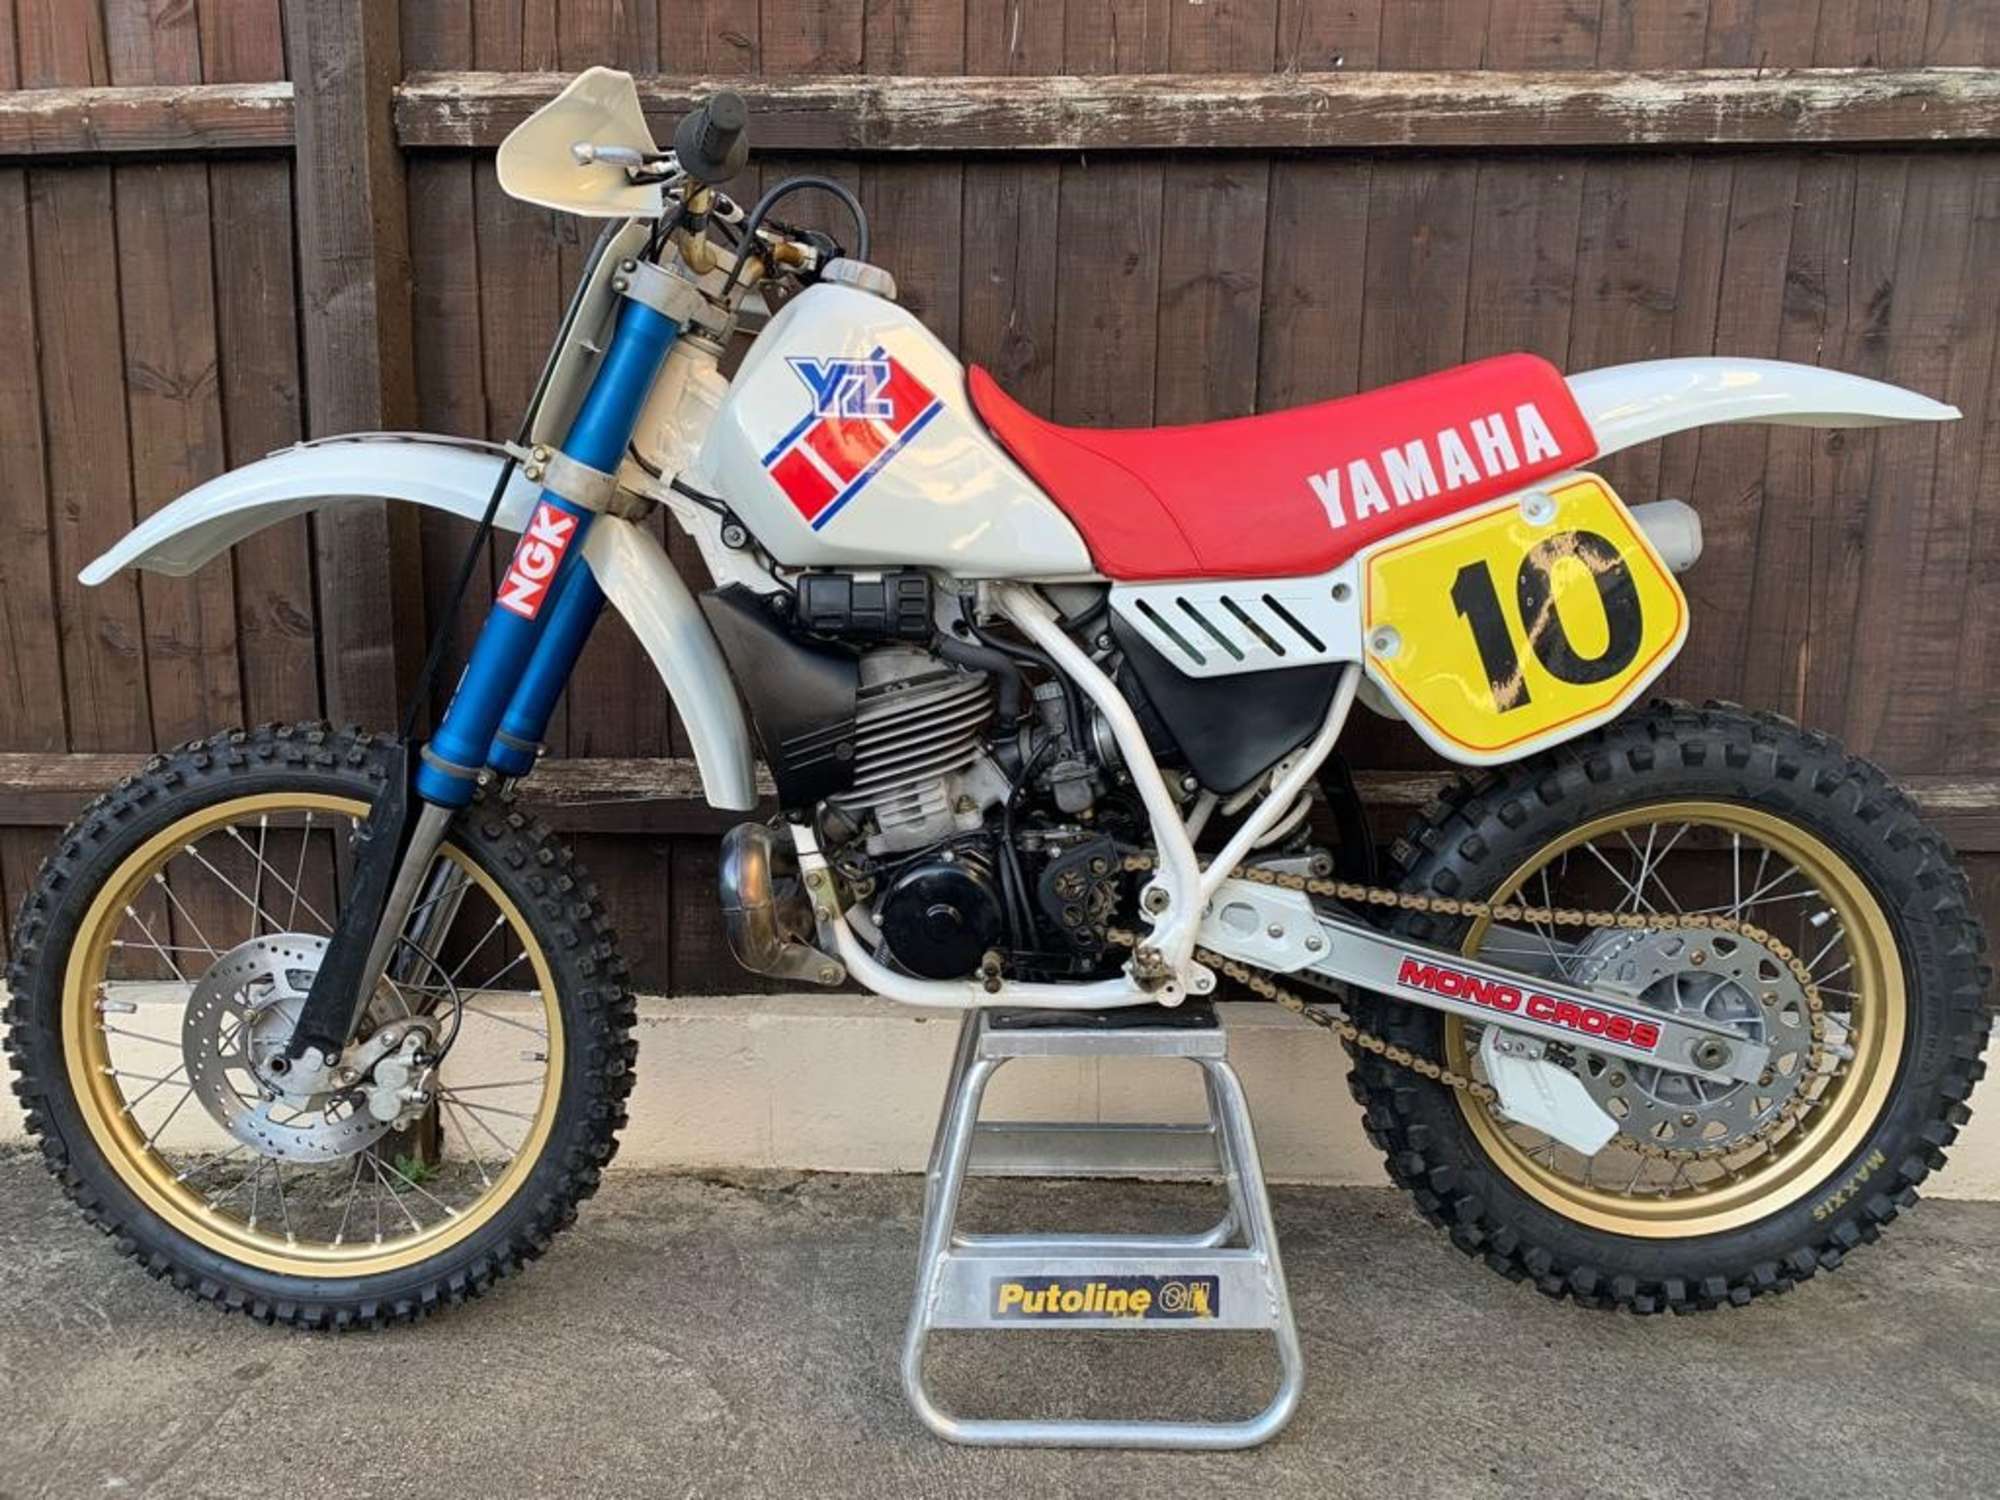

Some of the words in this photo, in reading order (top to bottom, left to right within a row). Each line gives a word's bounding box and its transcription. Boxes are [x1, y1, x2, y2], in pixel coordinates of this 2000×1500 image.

[784, 356, 894, 420] YZ
[1307, 402, 1562, 529] YAMAHA
[500, 504, 575, 617] NGK
[1451, 529, 1644, 714] 10
[1399, 958, 1522, 1012] MONO
[1526, 994, 1661, 1049] CROSS
[1812, 1149, 1886, 1221] MAXXIS
[997, 1282, 1152, 1314] Putoline
